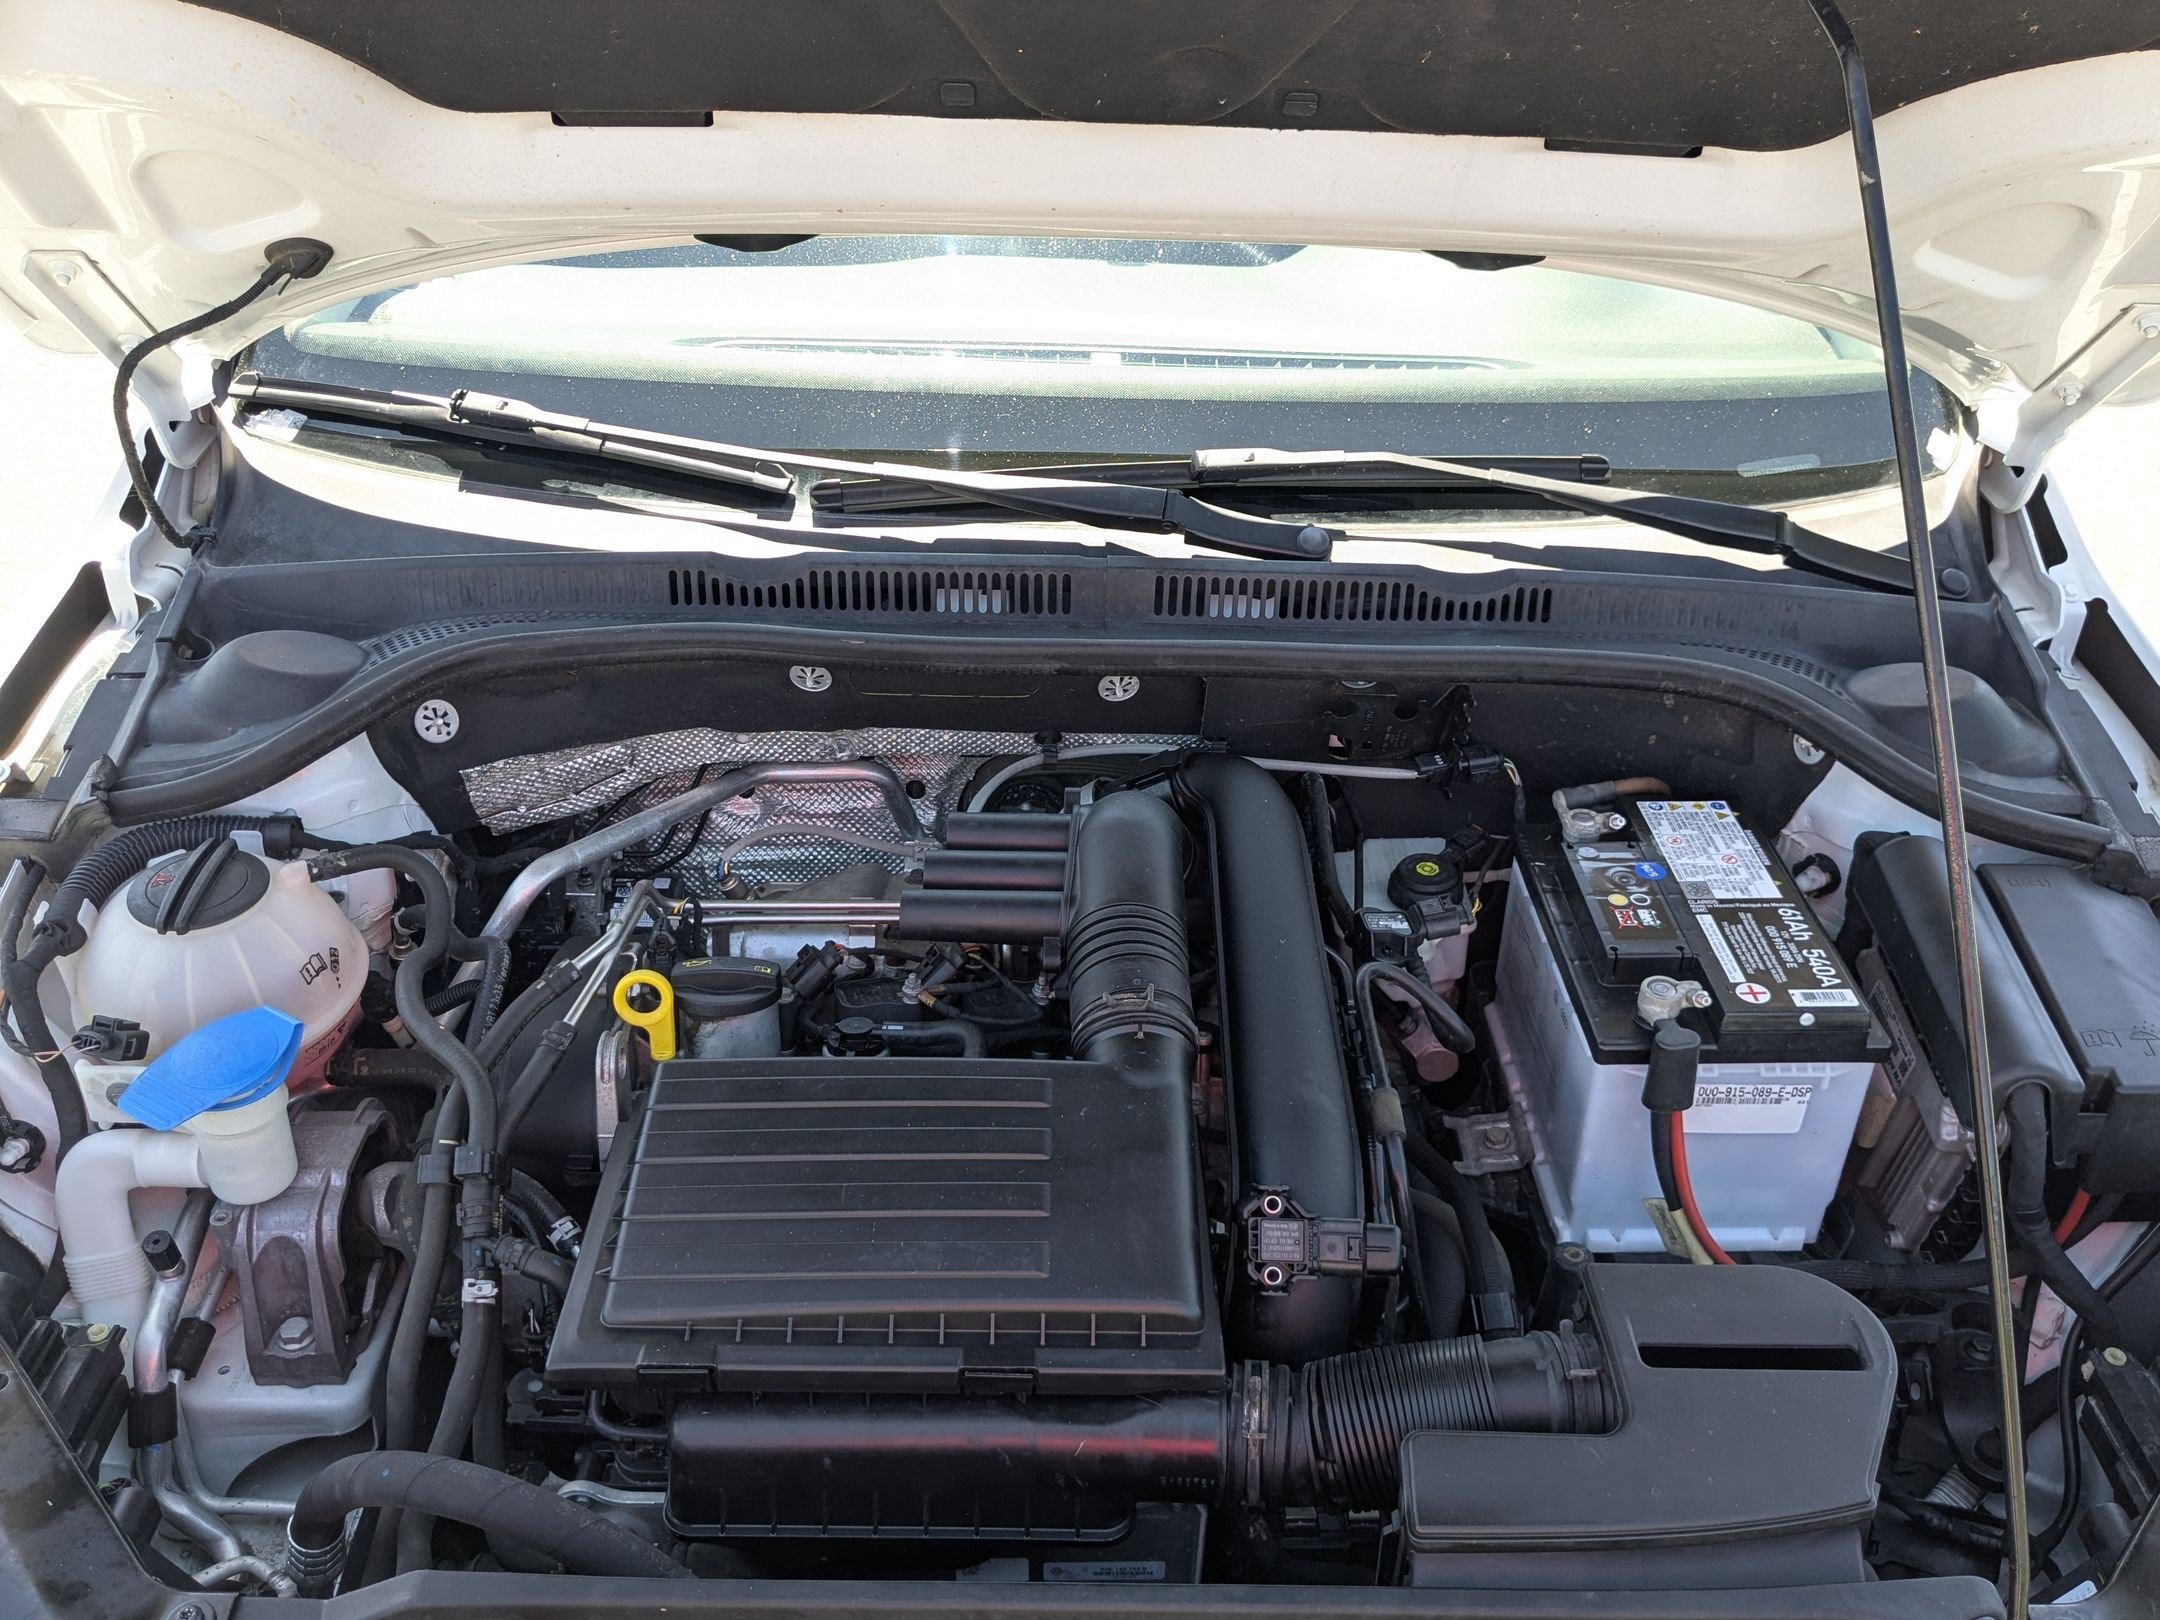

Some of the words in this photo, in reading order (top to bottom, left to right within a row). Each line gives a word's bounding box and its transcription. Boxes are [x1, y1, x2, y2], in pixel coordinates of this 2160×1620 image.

[1772, 937, 1788, 949] 915
[1777, 908, 1814, 941] 61Ah
[1802, 949, 1842, 987] 540A
